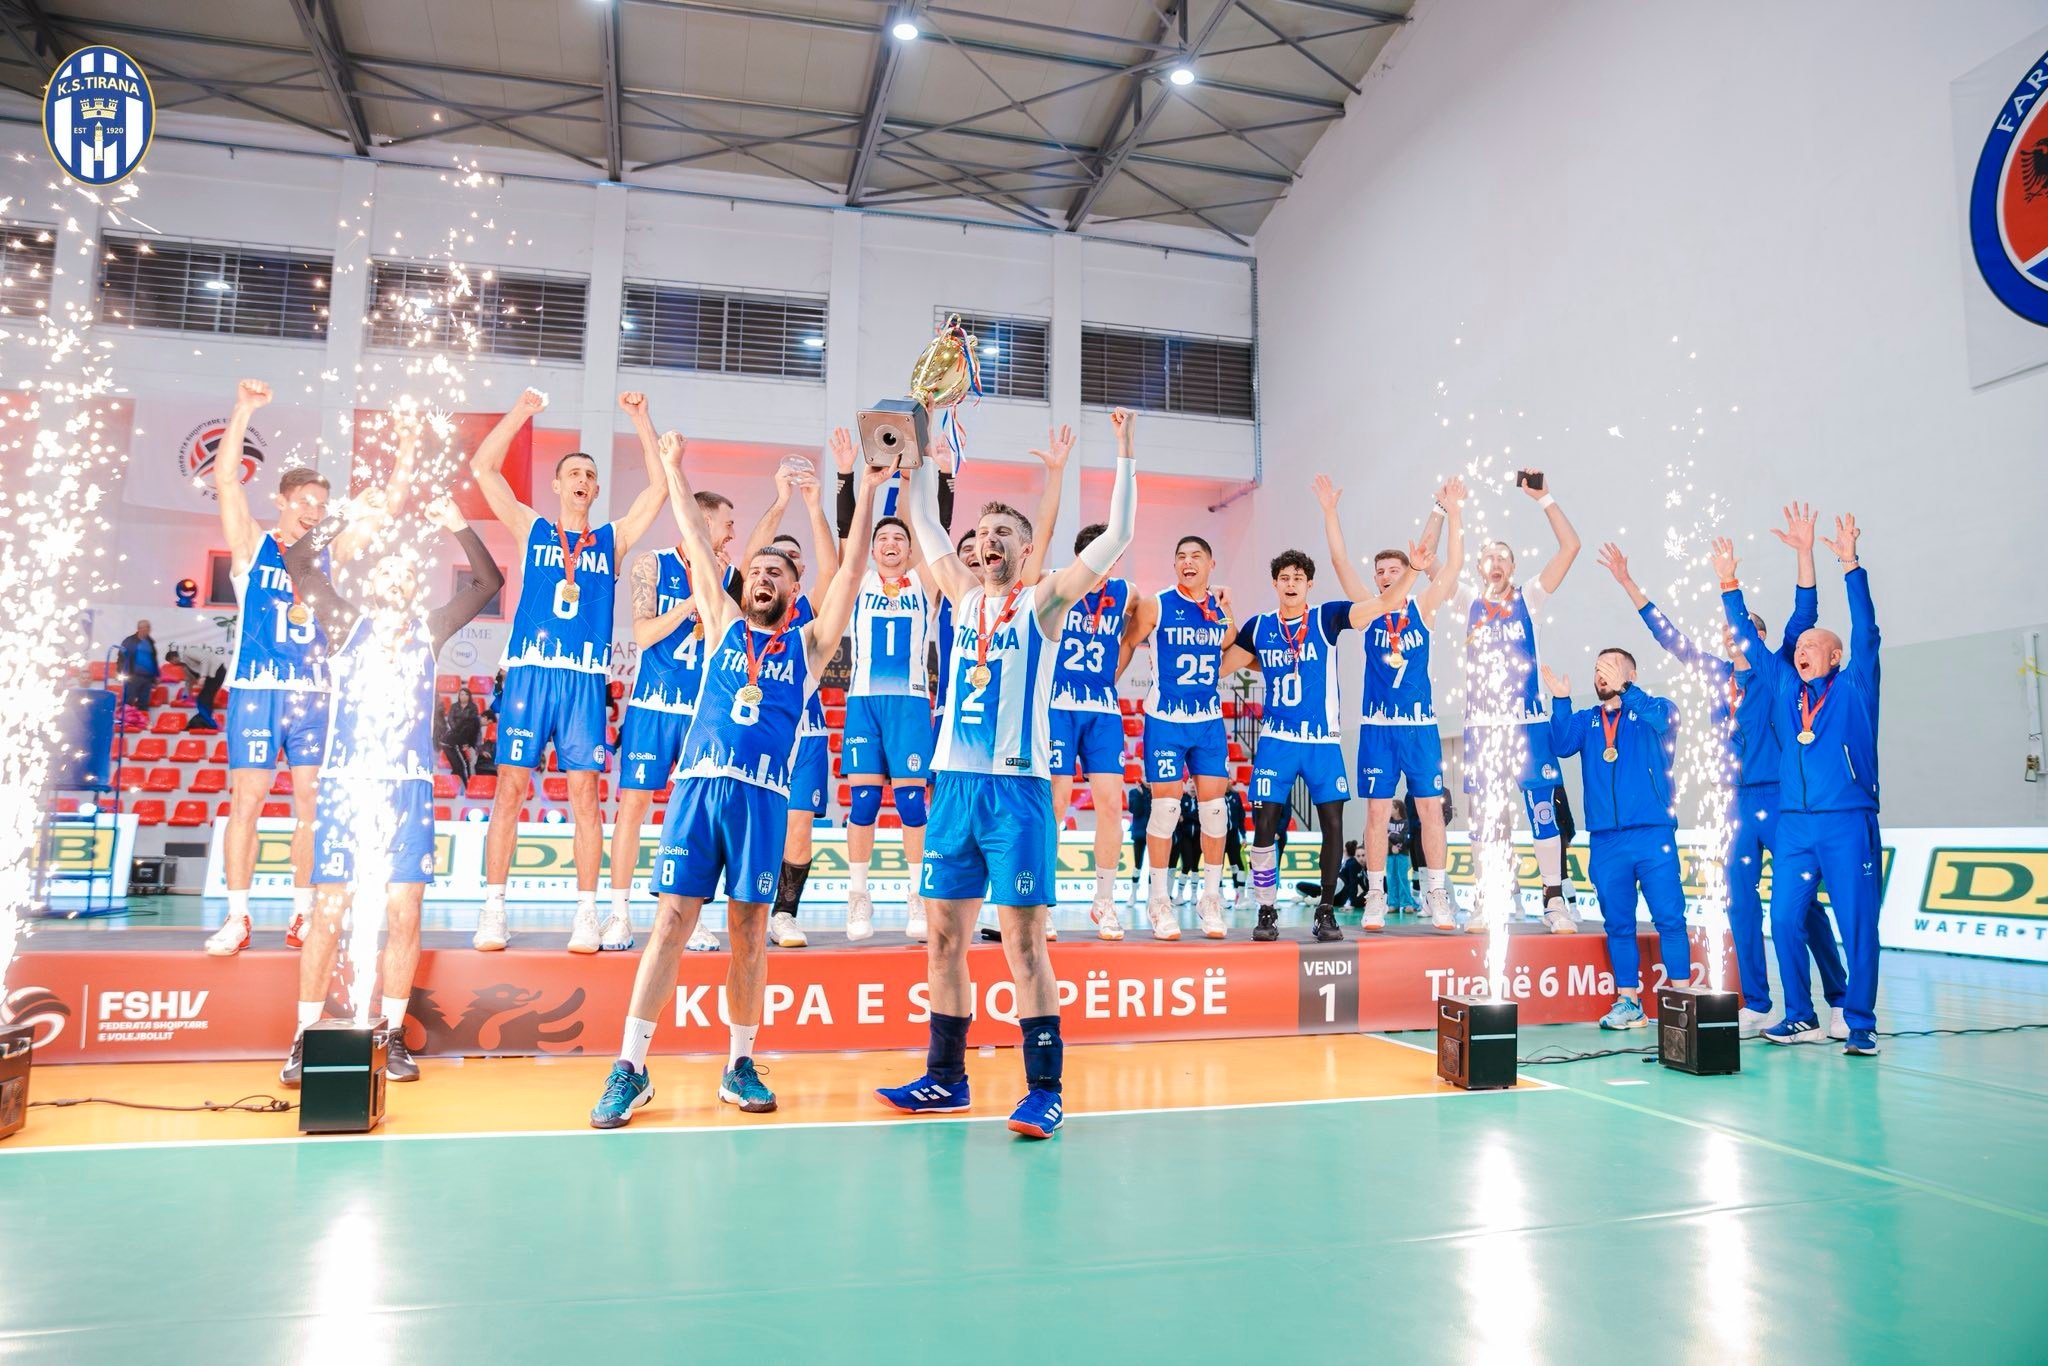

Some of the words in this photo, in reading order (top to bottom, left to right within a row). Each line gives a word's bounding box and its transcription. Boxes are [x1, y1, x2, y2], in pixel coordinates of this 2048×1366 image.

[673, 632, 697, 670] 4
[885, 620, 895, 656] 1
[1063, 637, 1105, 673] 23
[1176, 653, 1216, 685] 25
[960, 666, 987, 713] 2
[1272, 672, 1302, 707] 10
[247, 740, 269, 763] 13
[510, 739, 524, 761] 6
[851, 747, 858, 768] 1
[634, 763, 646, 784] 4
[1157, 759, 1177, 778] 25
[1255, 777, 1271, 797] 10
[1368, 777, 1376, 794] 7
[661, 859, 676, 886] 8
[924, 863, 935, 889] 2
[1303, 960, 1352, 976] VENDI
[1539, 966, 1560, 998] 6
[1567, 964, 1645, 996] Mas
[99, 990, 210, 1020] FSHV
[857, 983, 885, 1024] E
[1318, 983, 1336, 1022] 1
[98, 1020, 152, 1031] FEDERATA
[153, 1020, 209, 1031] SHQIPTARE
[107, 1031, 174, 1041] VOLEJBOLLIT
